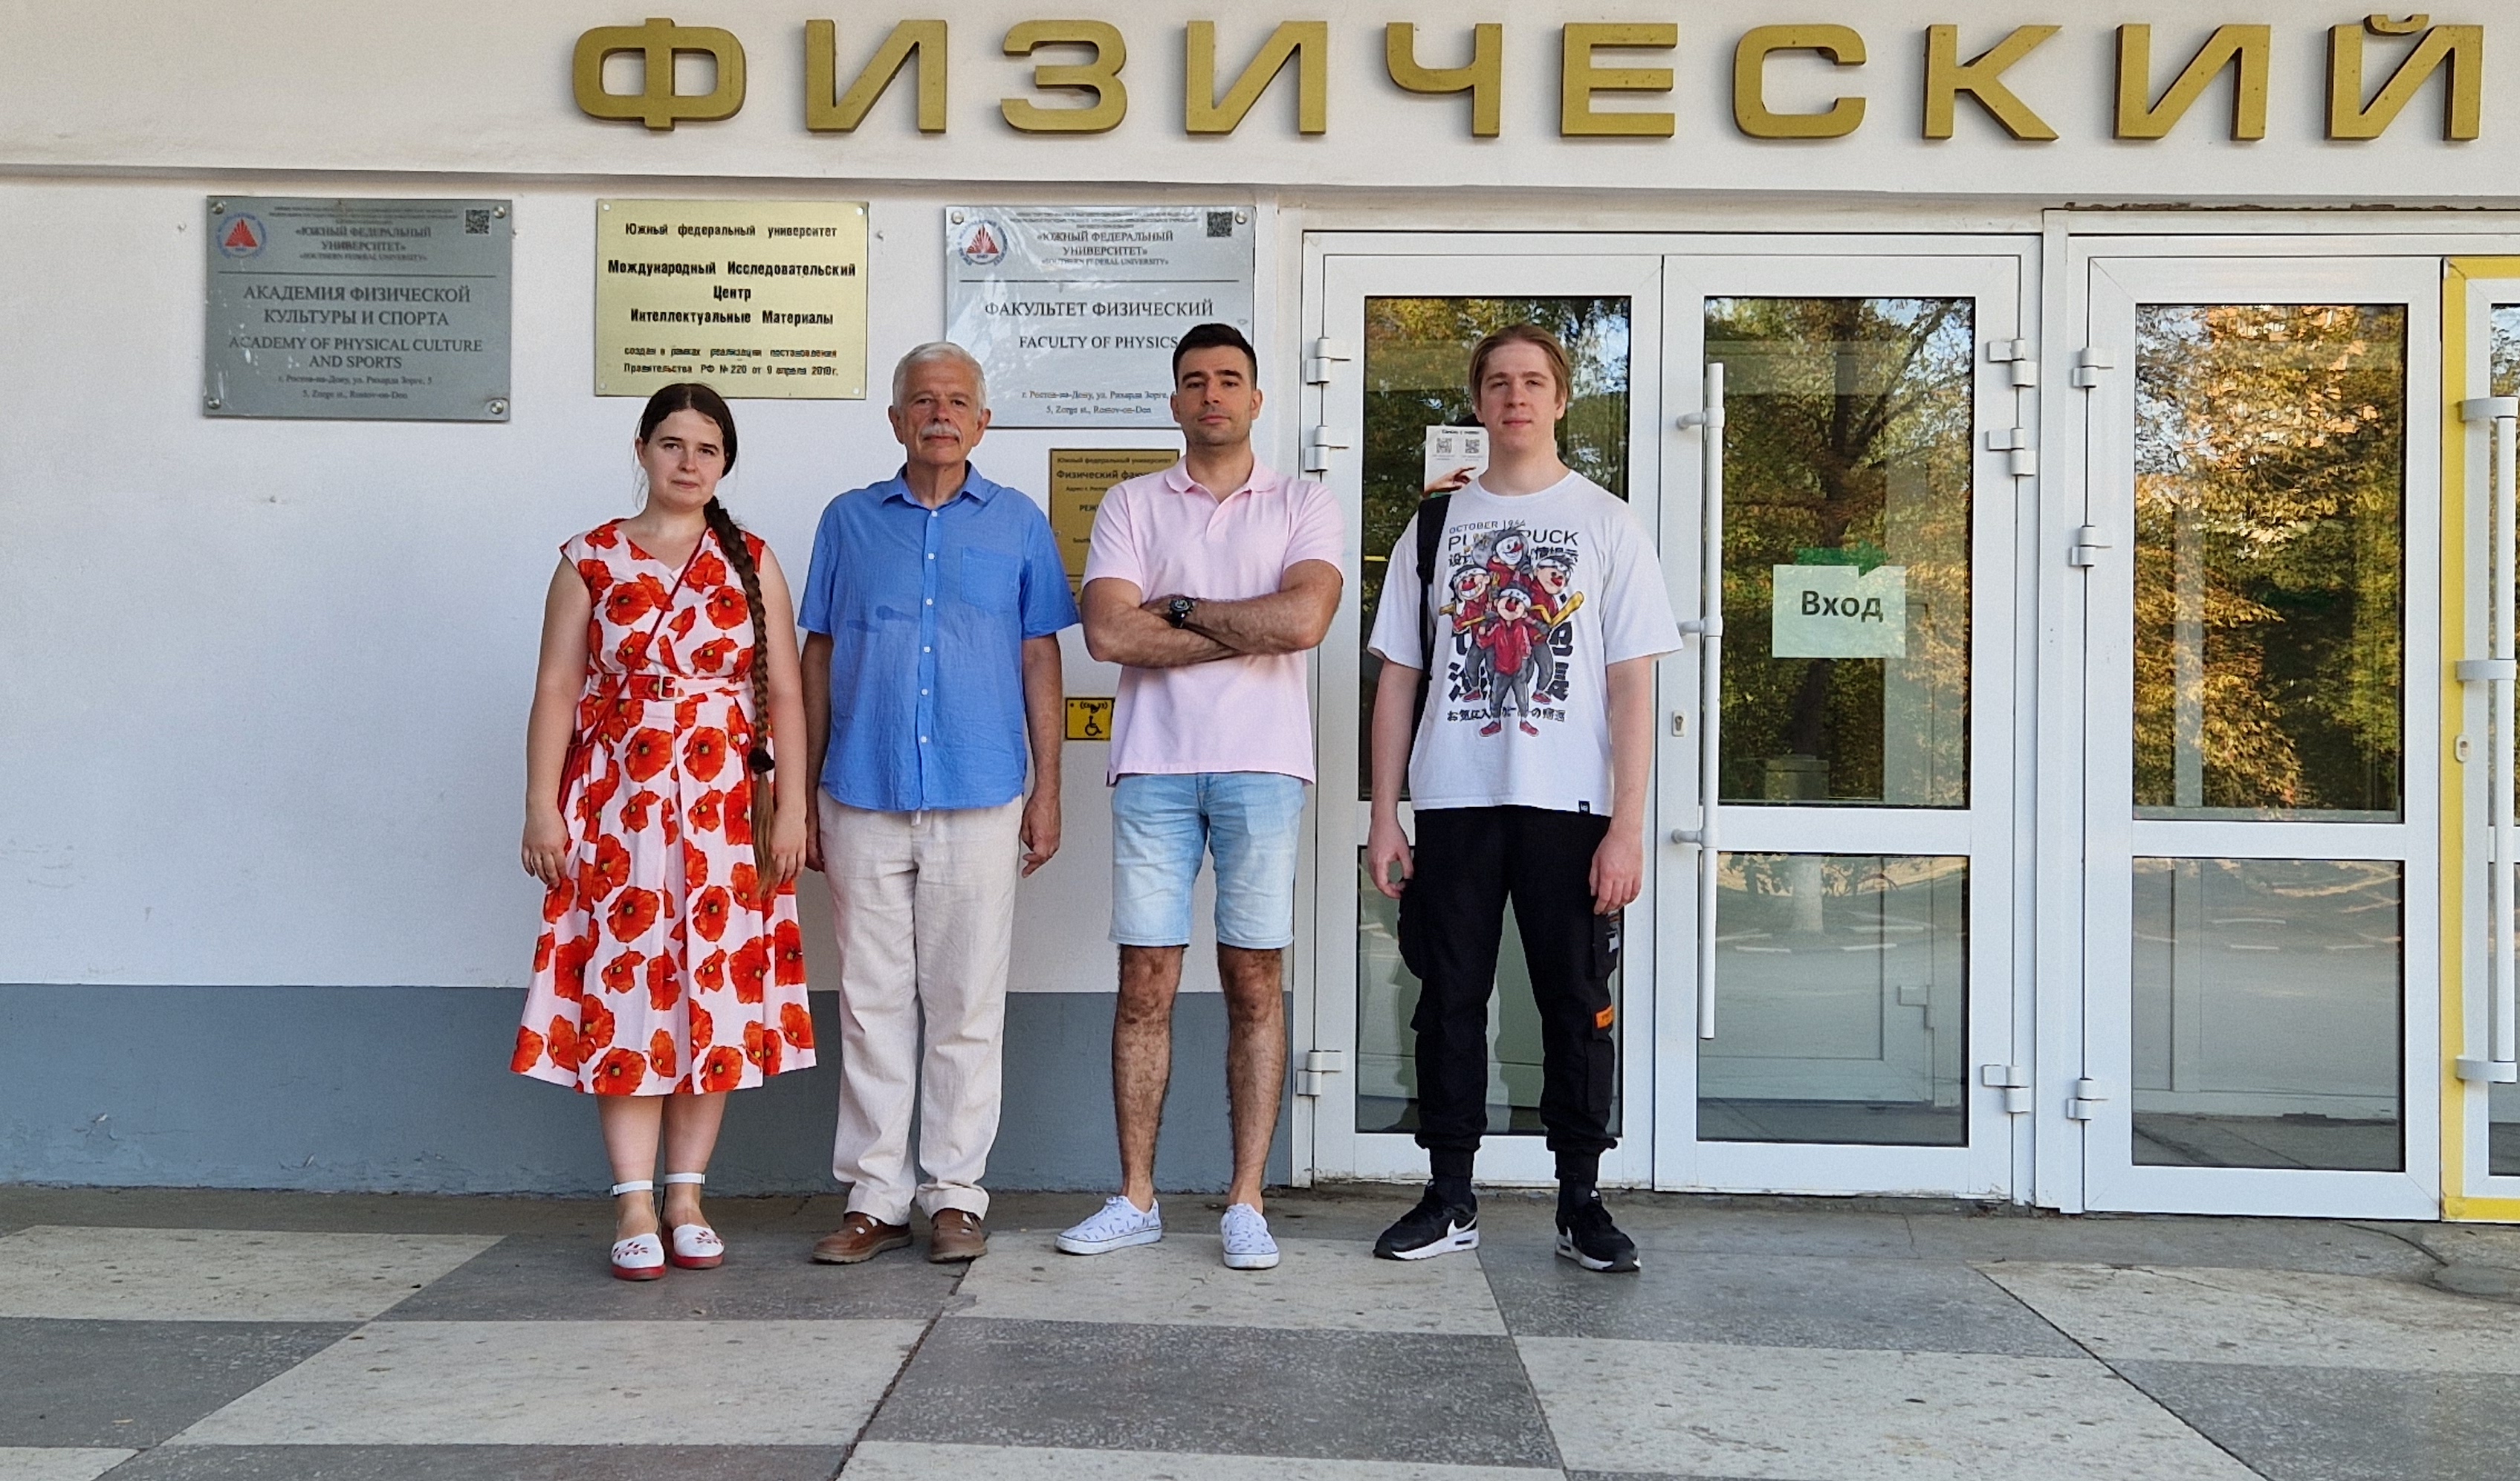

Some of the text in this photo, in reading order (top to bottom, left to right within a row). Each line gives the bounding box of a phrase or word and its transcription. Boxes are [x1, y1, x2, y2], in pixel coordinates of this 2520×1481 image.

[572, 13, 2484, 141] ФИЗИЧЕСКИЙ
[350, 226, 432, 237] ФЕДЕРАЛЬНЫЙ
[626, 223, 838, 239] Южный федеральный университет
[1037, 230, 1173, 242] «ЮЖНЫЙ ФЕДЕРАЛЬНЫЙ
[1063, 246, 1147, 256] УНИВЕРСИТЕТ»
[608, 259, 856, 277] Международный Исследовательский
[244, 285, 470, 302] АКАДЕМИЯ ФИЗИЧЕСКОЙ
[713, 285, 751, 302] Центр
[985, 298, 1214, 317] ФАКУЛЬТЕТ ФИЗИЧЕСКИЙ
[264, 309, 449, 325] КУЛЬТУРЫ И СПОРТА
[631, 308, 833, 327] Интеллектуальные Материалы
[229, 337, 483, 351] ACADEMY OF PHYSICAL CULTURE
[1020, 336, 1178, 349] FACULTY OF PHYSICS
[309, 356, 402, 369] AND SPORTS
[623, 363, 692, 375] Правительства
[701, 364, 715, 373] РФ
[752, 366, 761, 374] от
[767, 365, 772, 374] 9
[1057, 470, 1118, 479] Физический
[1449, 521, 1498, 534] OCTOBER
[1801, 590, 1884, 623] Вход
